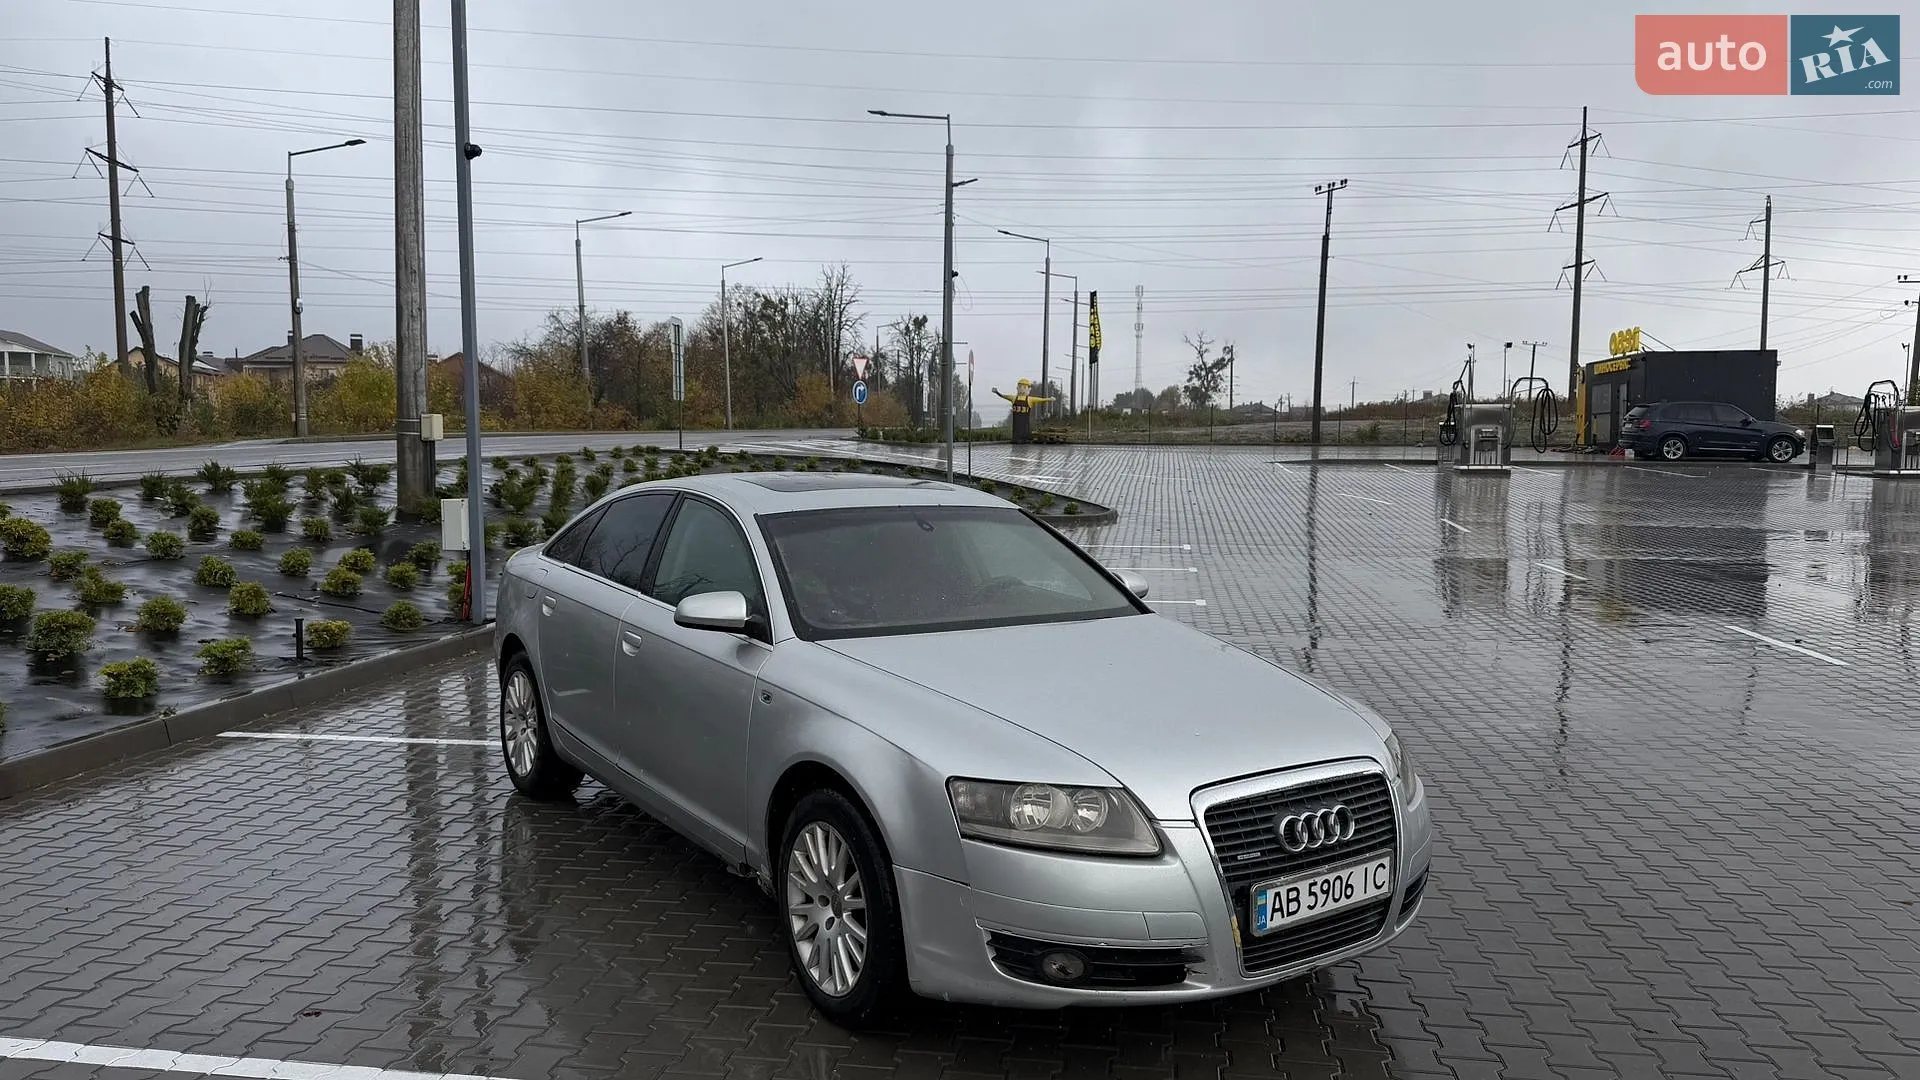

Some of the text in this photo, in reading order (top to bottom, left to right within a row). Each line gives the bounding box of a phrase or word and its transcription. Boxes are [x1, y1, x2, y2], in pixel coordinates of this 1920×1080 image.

[1269, 863, 1386, 922] AB 5906 IC
